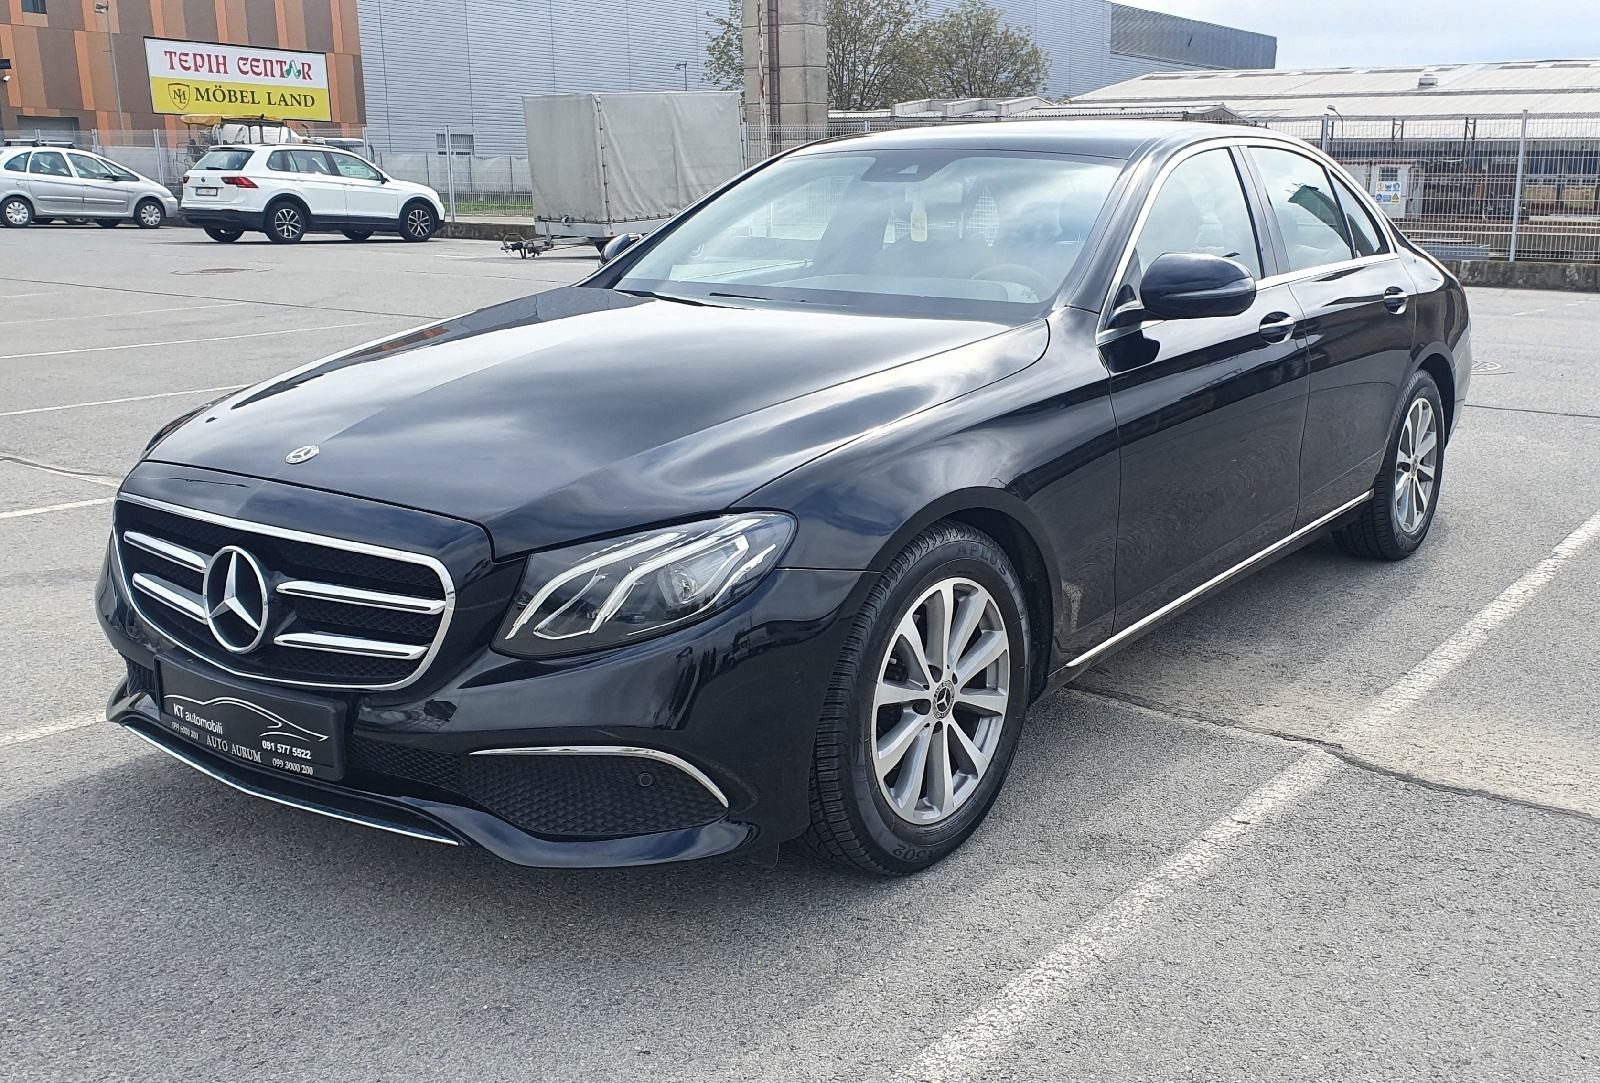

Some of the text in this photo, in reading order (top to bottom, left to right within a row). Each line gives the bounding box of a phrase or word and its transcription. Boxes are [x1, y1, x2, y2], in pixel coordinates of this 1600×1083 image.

[164, 51, 229, 74] TEPIH
[194, 85, 315, 107] MÖBEL LAND
[173, 703, 223, 735] KT automobili
[206, 734, 262, 763] AUTO AURUM
[261, 740, 312, 760] 091 577 5522
[272, 757, 284, 768] 099
[284, 760, 301, 773] 3000
